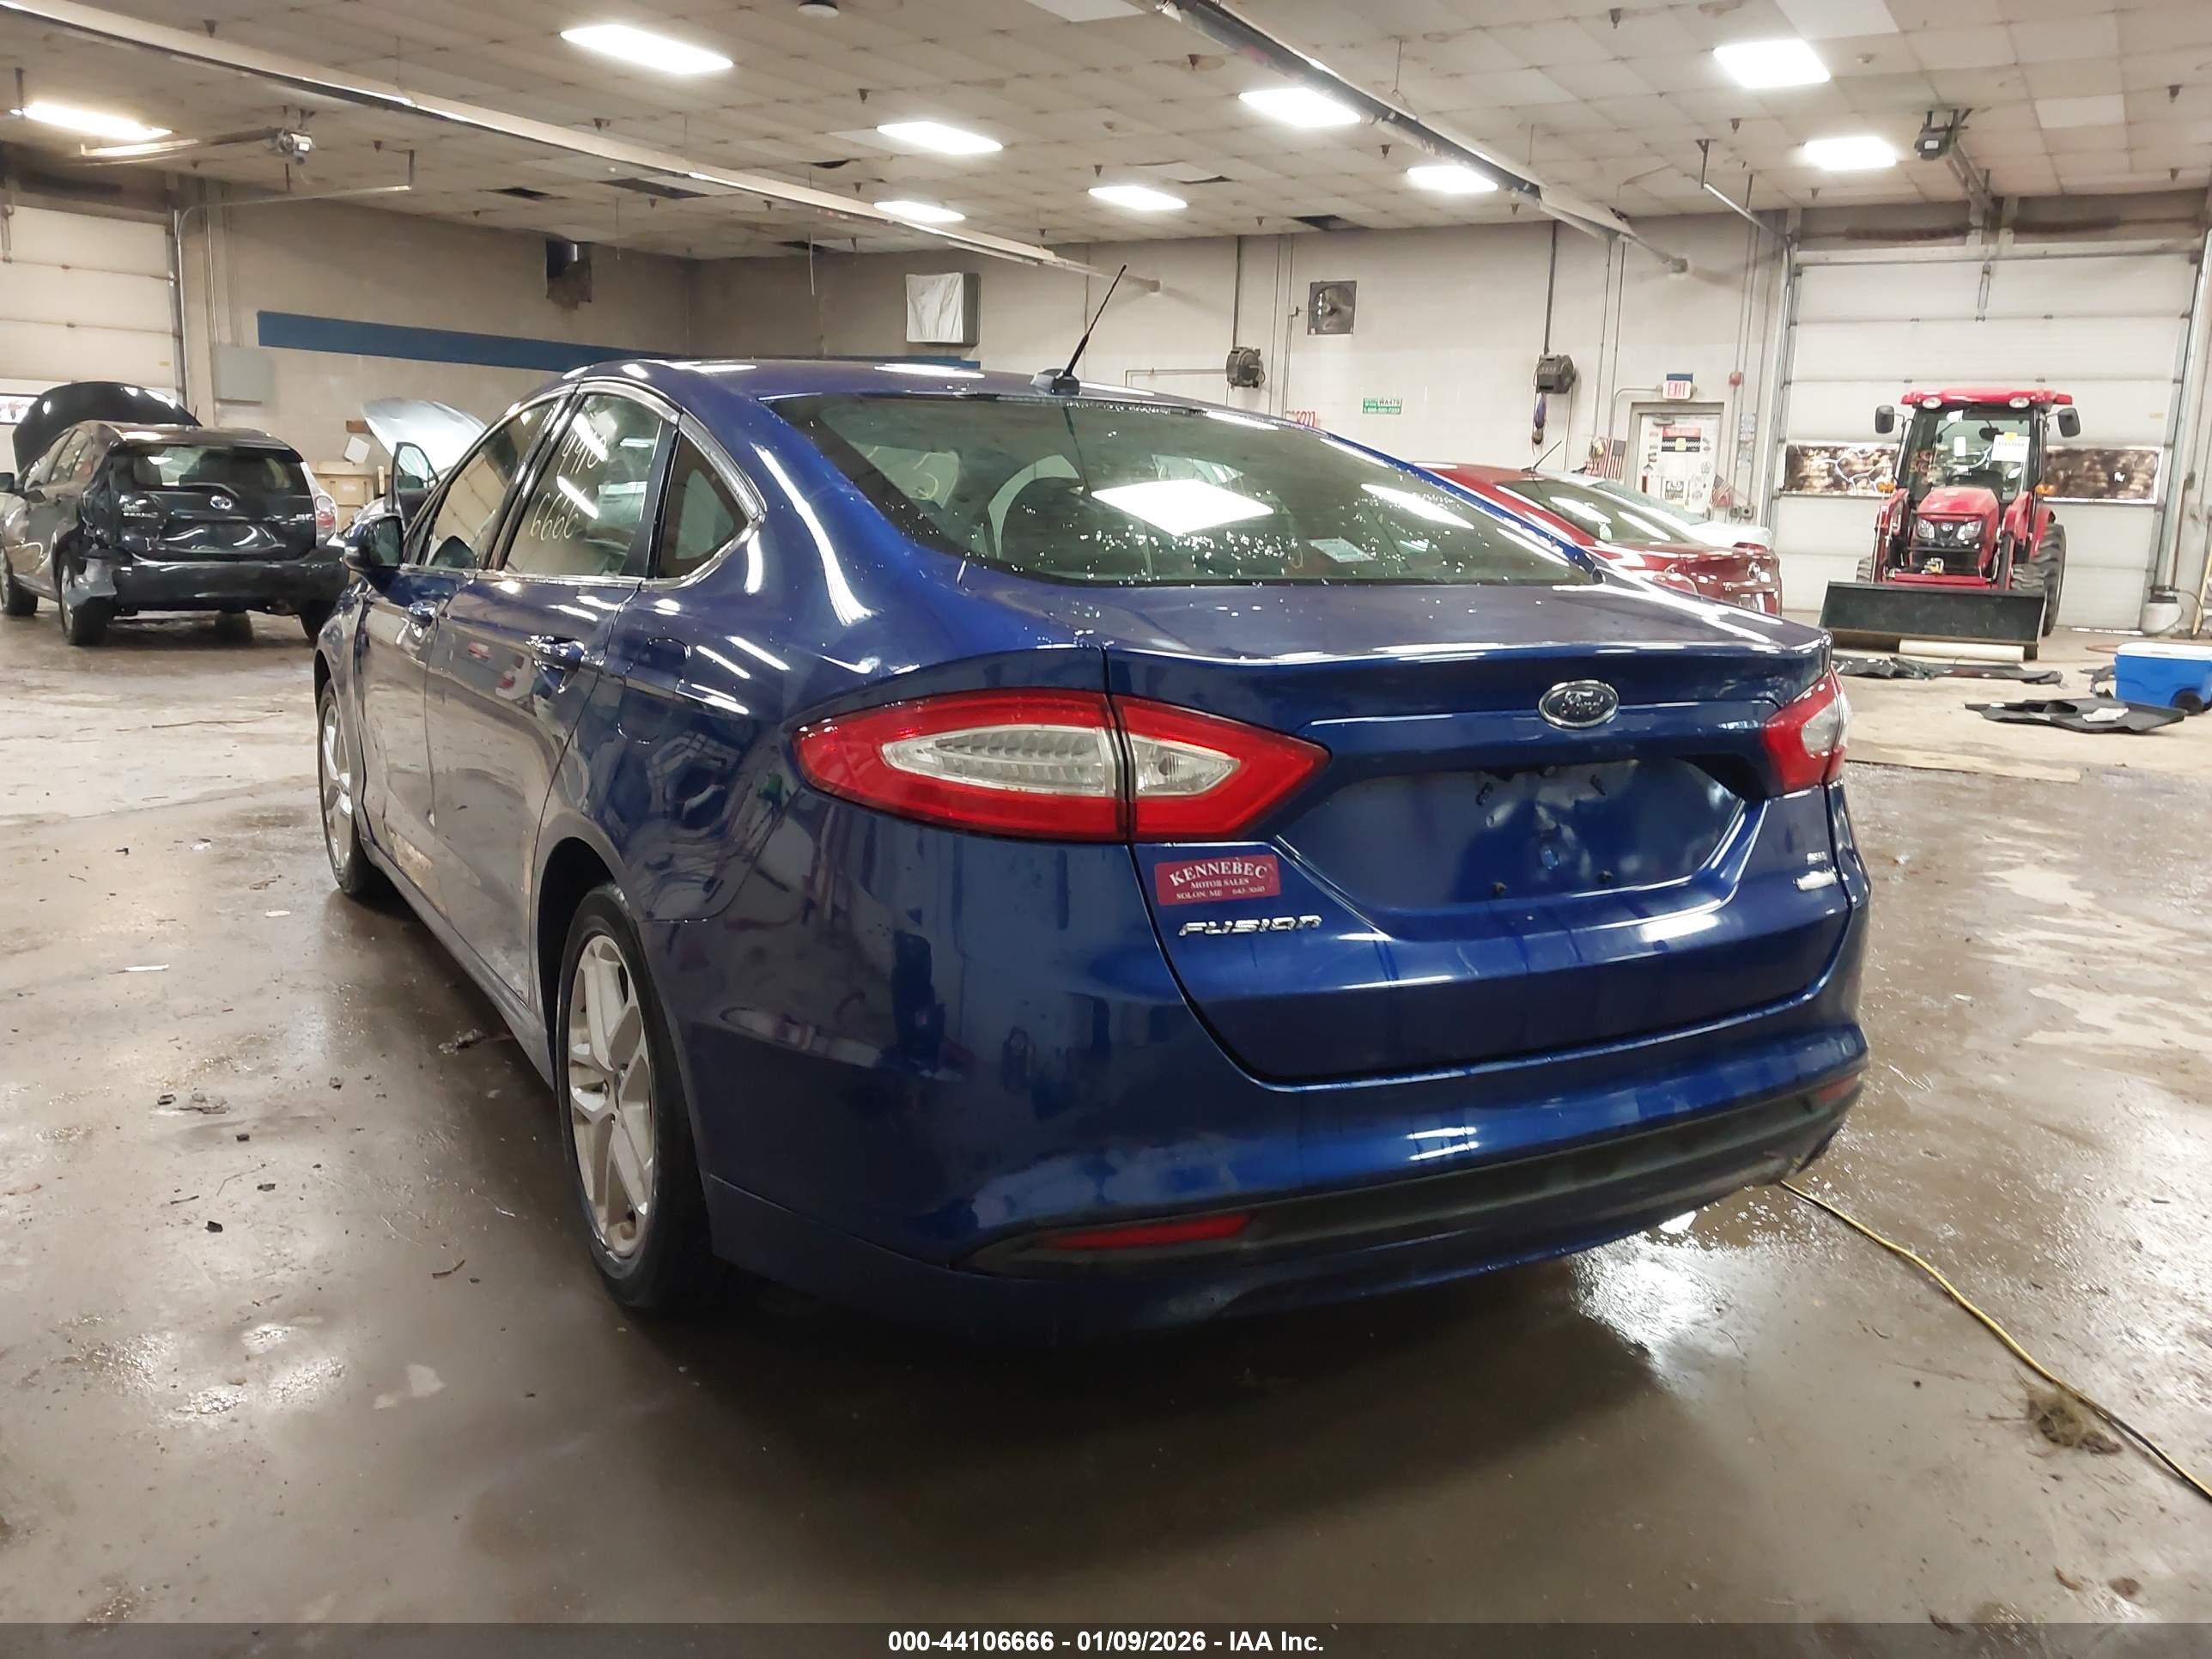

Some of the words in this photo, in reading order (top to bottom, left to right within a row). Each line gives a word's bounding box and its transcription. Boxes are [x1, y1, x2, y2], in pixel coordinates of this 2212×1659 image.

[1668, 381, 1687, 397] EXIT
[1169, 860, 1267, 887] KENNEBEC
[1190, 878, 1223, 889] MOTOR
[1224, 877, 1249, 887] SALES
[1178, 915, 1322, 936] FUSION
